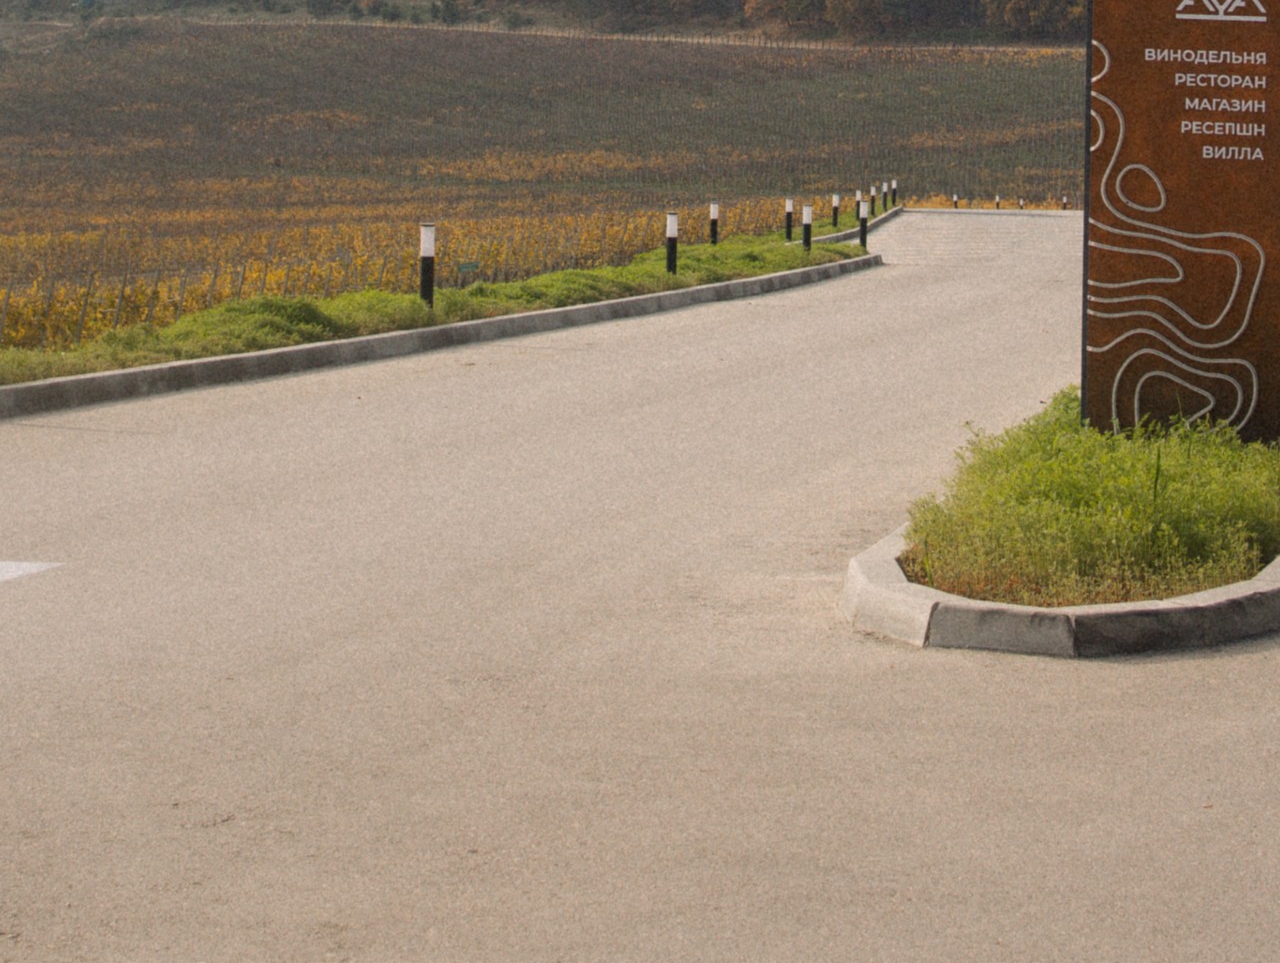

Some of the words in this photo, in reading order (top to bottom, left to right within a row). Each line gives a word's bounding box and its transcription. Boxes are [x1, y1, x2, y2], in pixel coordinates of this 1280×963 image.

[1144, 48, 1267, 64] ВИНОДЕЛЬНЯ
[1174, 73, 1267, 89] РЕСТОРАН
[1184, 97, 1266, 113] МАГАЗИН
[1180, 121, 1266, 136] РЕСЕПШН
[1202, 145, 1264, 160] ВИЛЛА
